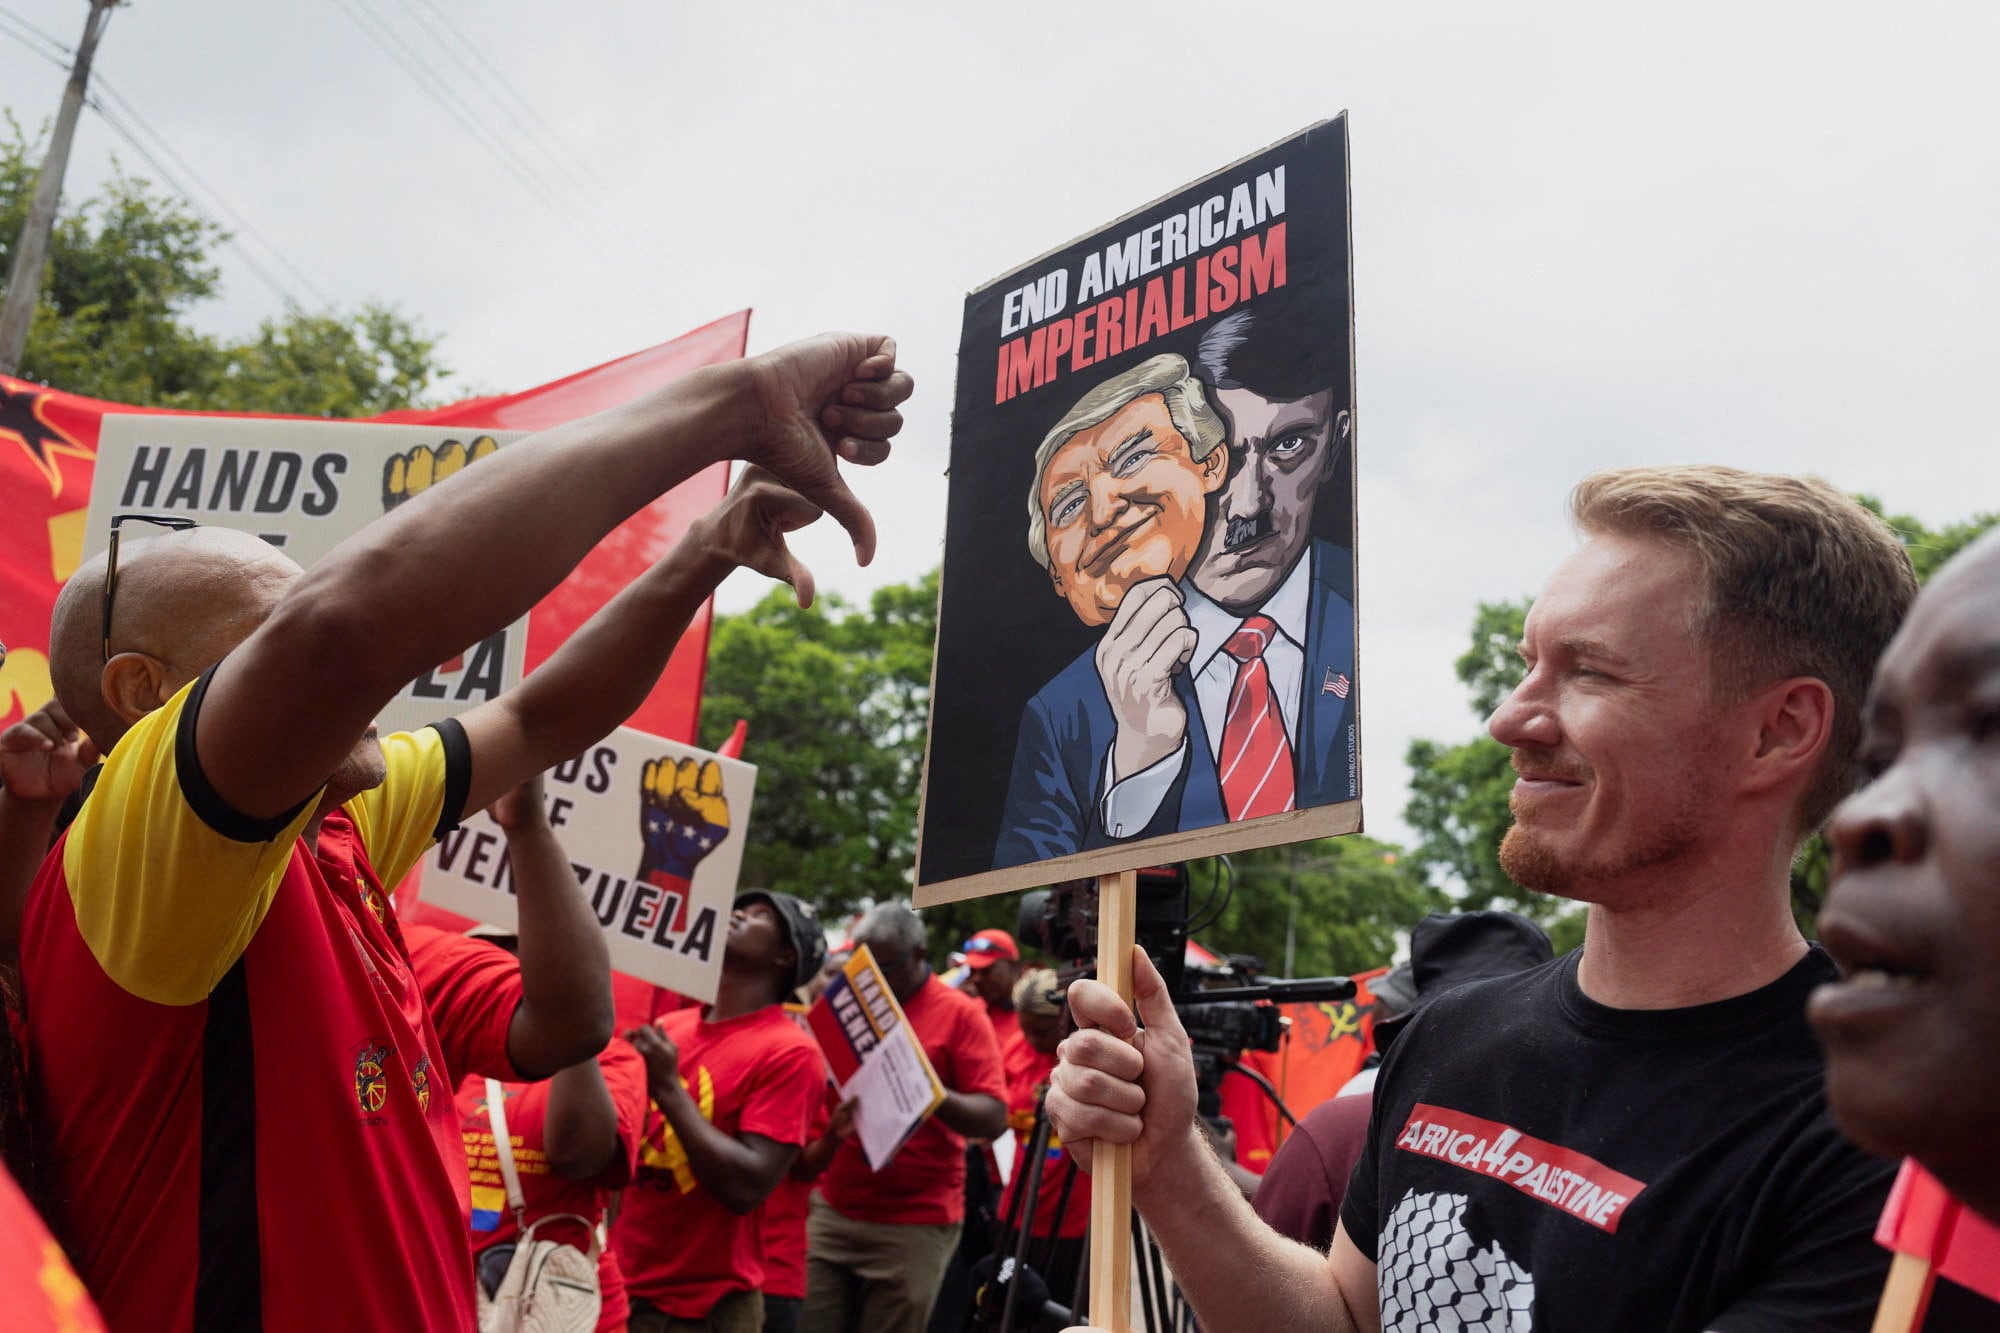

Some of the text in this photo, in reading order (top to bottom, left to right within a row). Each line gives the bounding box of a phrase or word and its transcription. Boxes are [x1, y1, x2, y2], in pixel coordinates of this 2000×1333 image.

[995, 221, 1287, 405] IMPERIALISM
[1000, 164, 1286, 338] END AMERICAN
[120, 446, 348, 516] HANDS
[436, 825, 717, 962] VENUELA
[832, 986, 877, 1057] VENE
